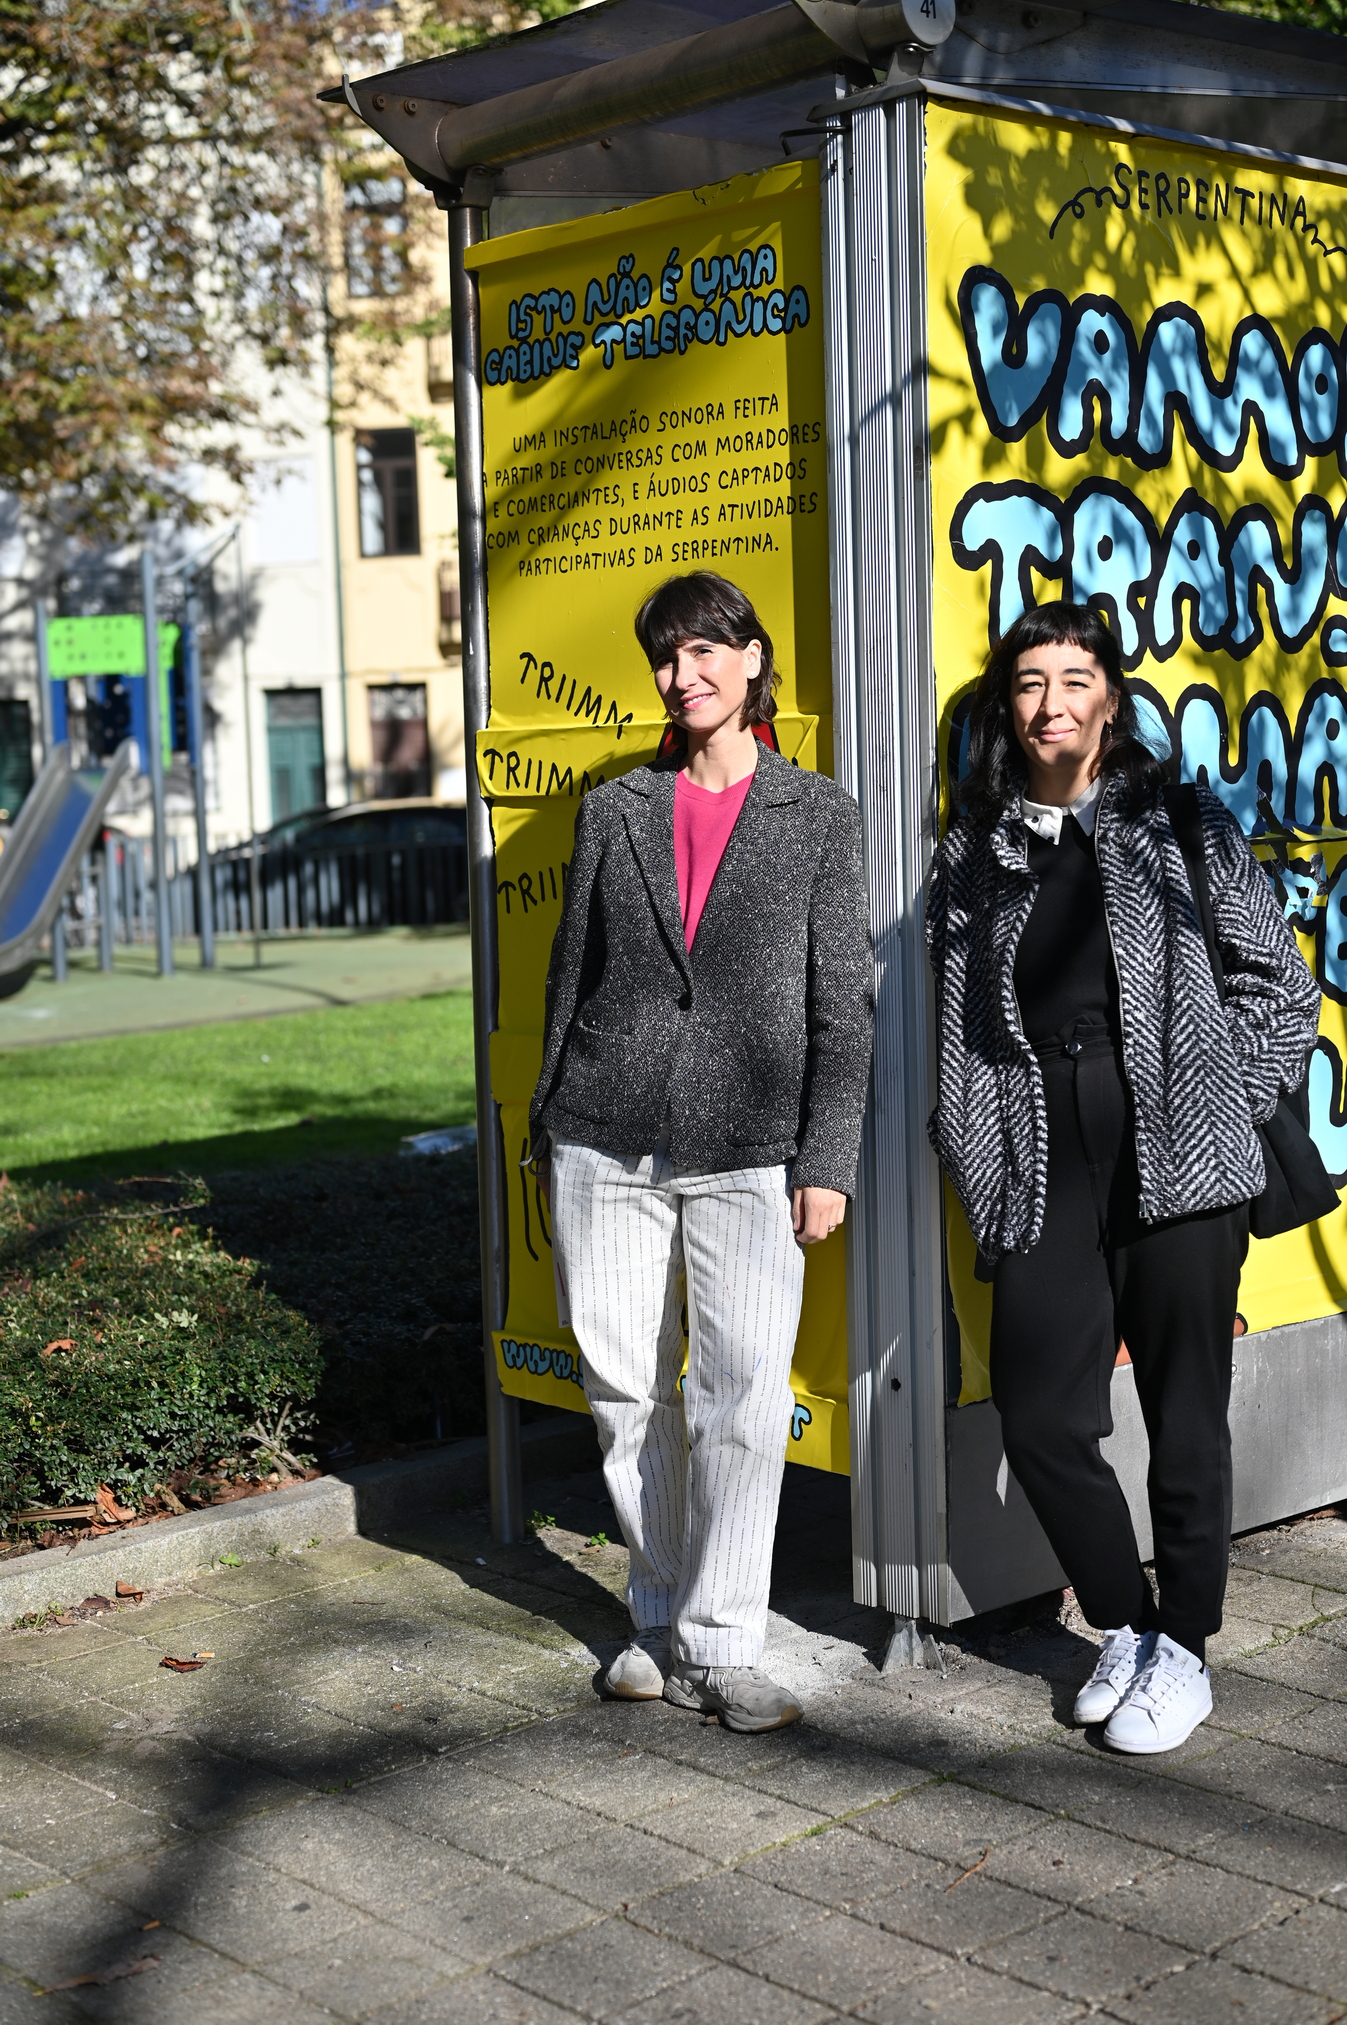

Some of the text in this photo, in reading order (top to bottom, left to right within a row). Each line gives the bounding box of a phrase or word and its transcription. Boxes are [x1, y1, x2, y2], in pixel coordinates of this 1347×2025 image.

[1113, 163, 1307, 231] SERPENTINA
[509, 244, 777, 341] ISTO NÃO É UMA
[485, 285, 810, 386] CABINE TELEFÓNICA
[958, 265, 1347, 480] VAMO
[495, 462, 543, 487] PARTIR
[550, 460, 567, 480] DE
[573, 444, 664, 476] CONVERSAS
[671, 439, 707, 462] COM
[715, 421, 822, 456] MORADORES
[513, 393, 779, 453] UMA INSTALAÇÃO SONORA FEITA
[486, 491, 819, 549] COM CRIANÇAS DURANTE AS ATIVIDADES
[493, 457, 808, 518] E COMERCIANTES, E ÁUDIOS CAPTADOS
[519, 532, 779, 577] PARTICIPATIVAS DA SERPENTINA.
[950, 476, 1347, 668] TRAN
[519, 651, 633, 740] TRIIMM
